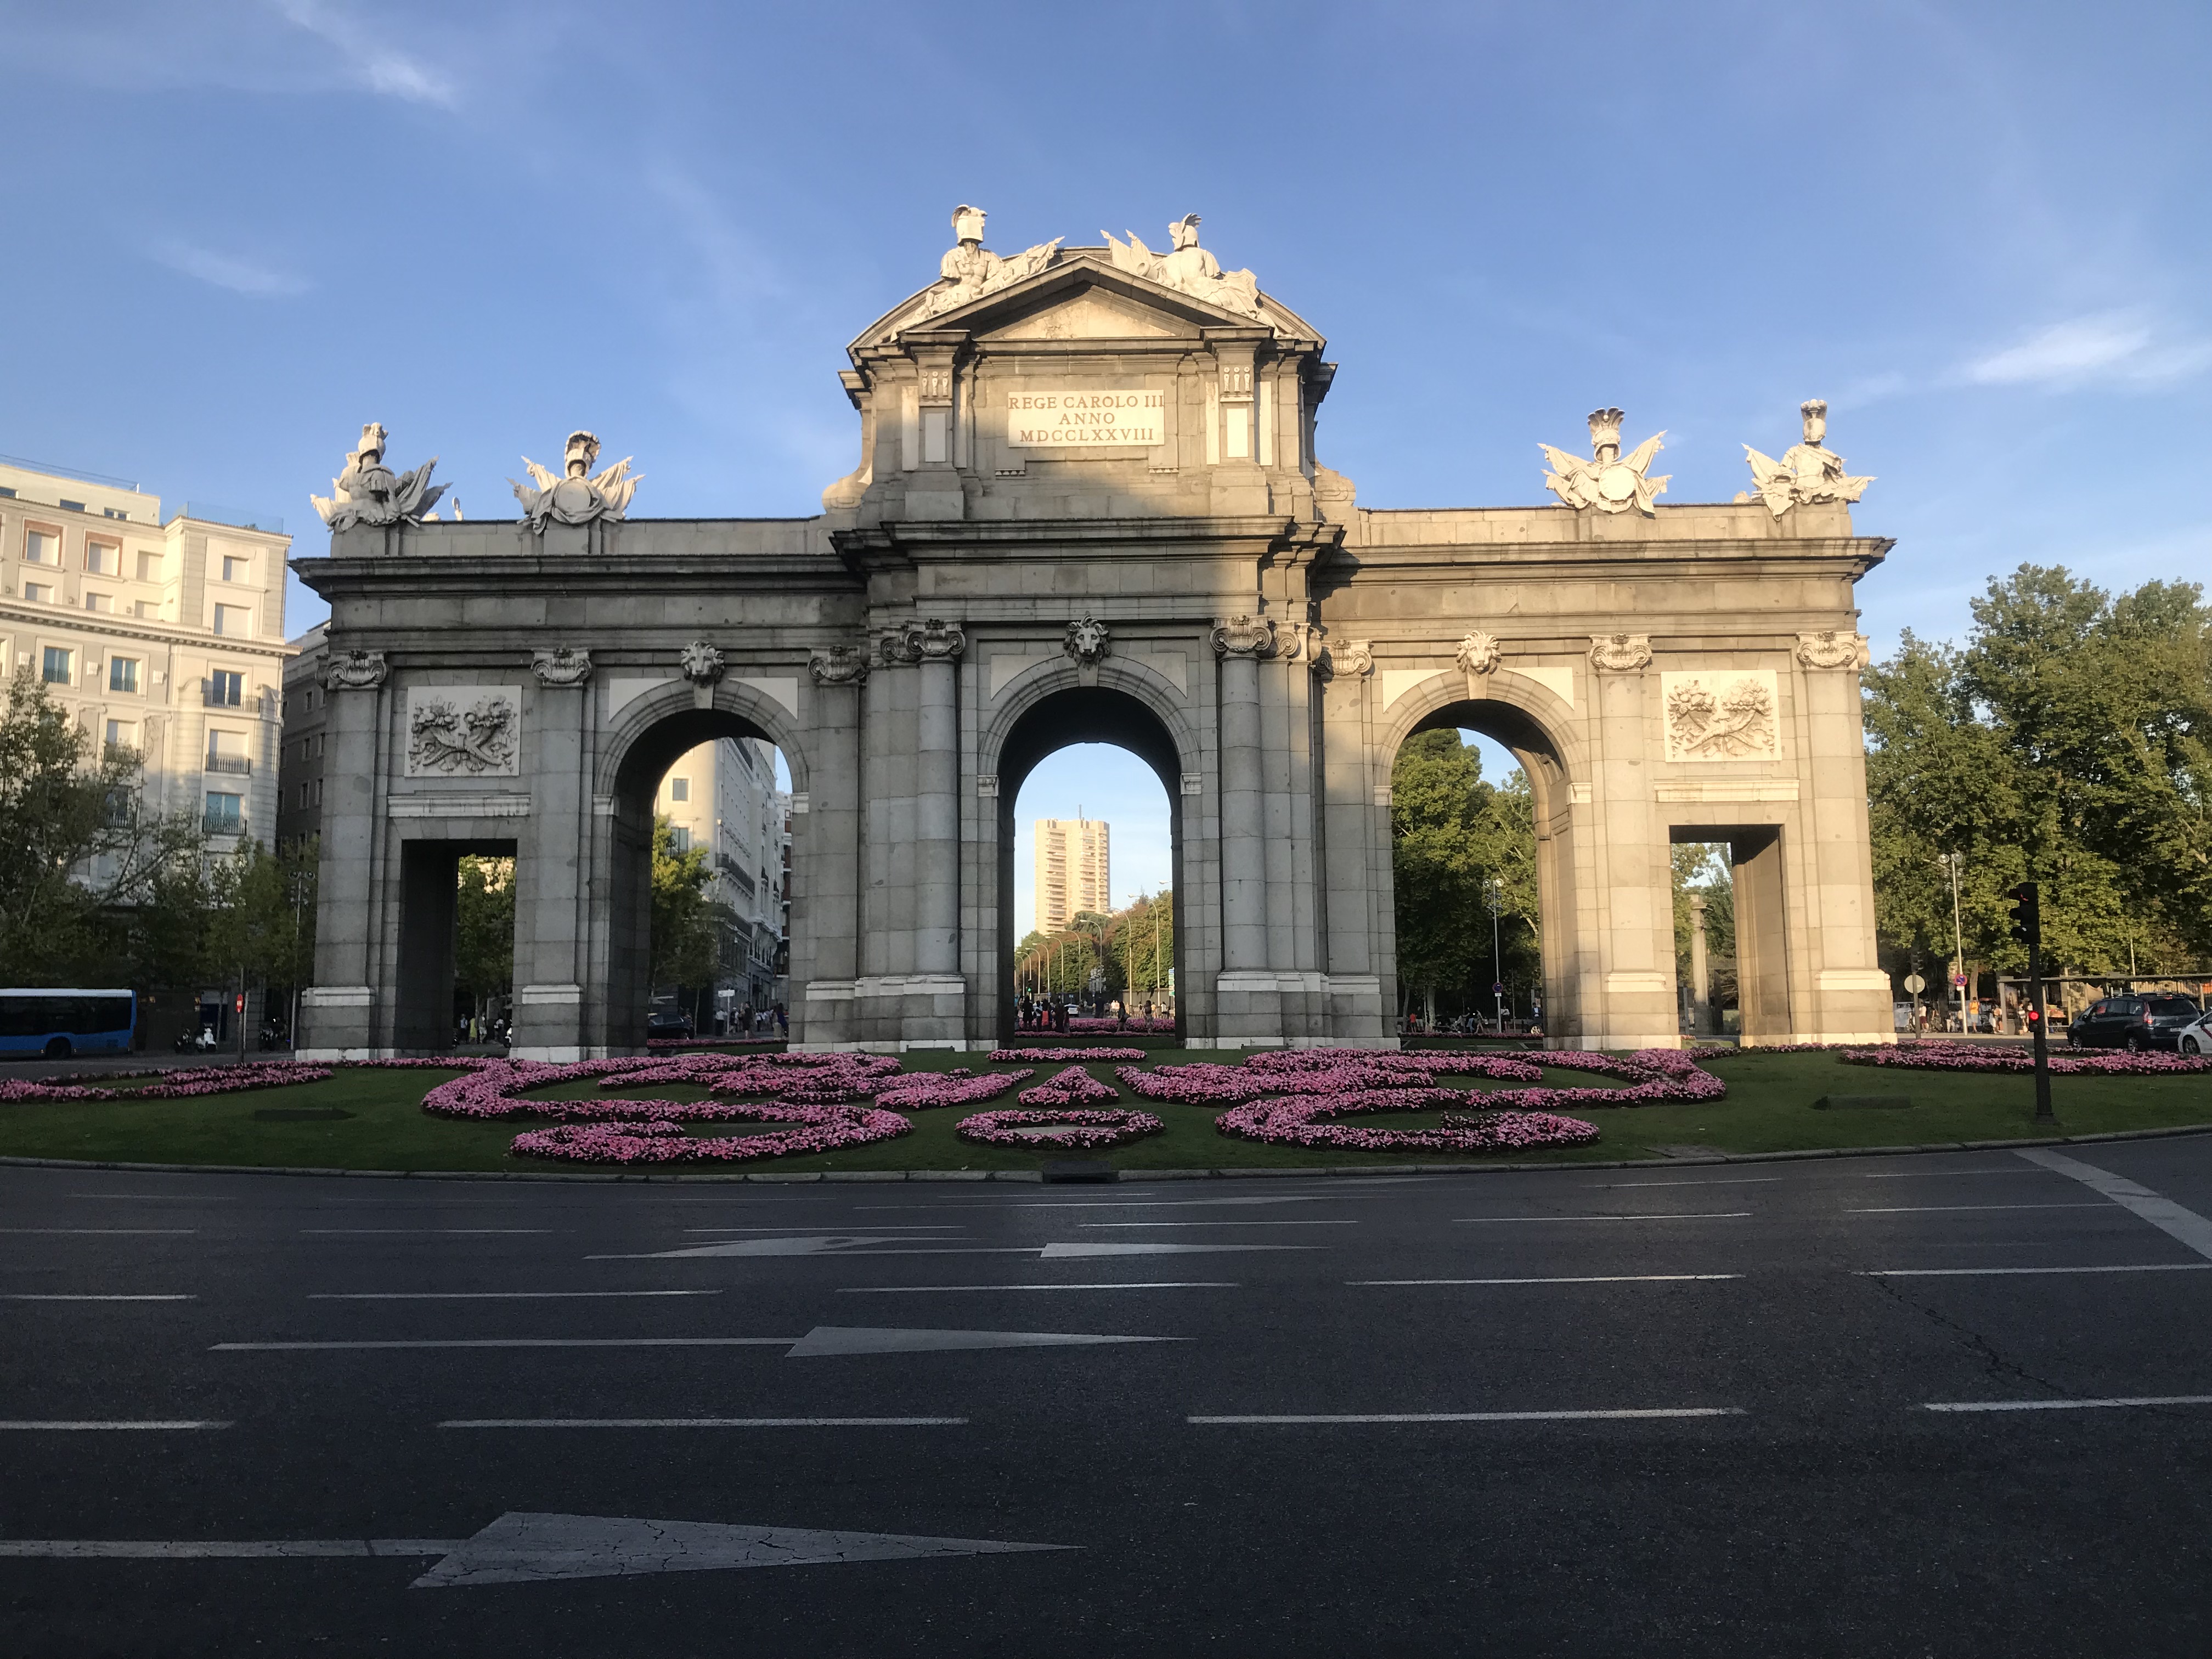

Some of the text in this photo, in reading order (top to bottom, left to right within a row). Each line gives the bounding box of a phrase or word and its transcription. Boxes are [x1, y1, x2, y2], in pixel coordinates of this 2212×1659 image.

[1008, 395, 1164, 409] REGE CAROLO III
[1058, 412, 1115, 425] ANNO
[1019, 428, 1154, 442] MDCCLXXVIII
